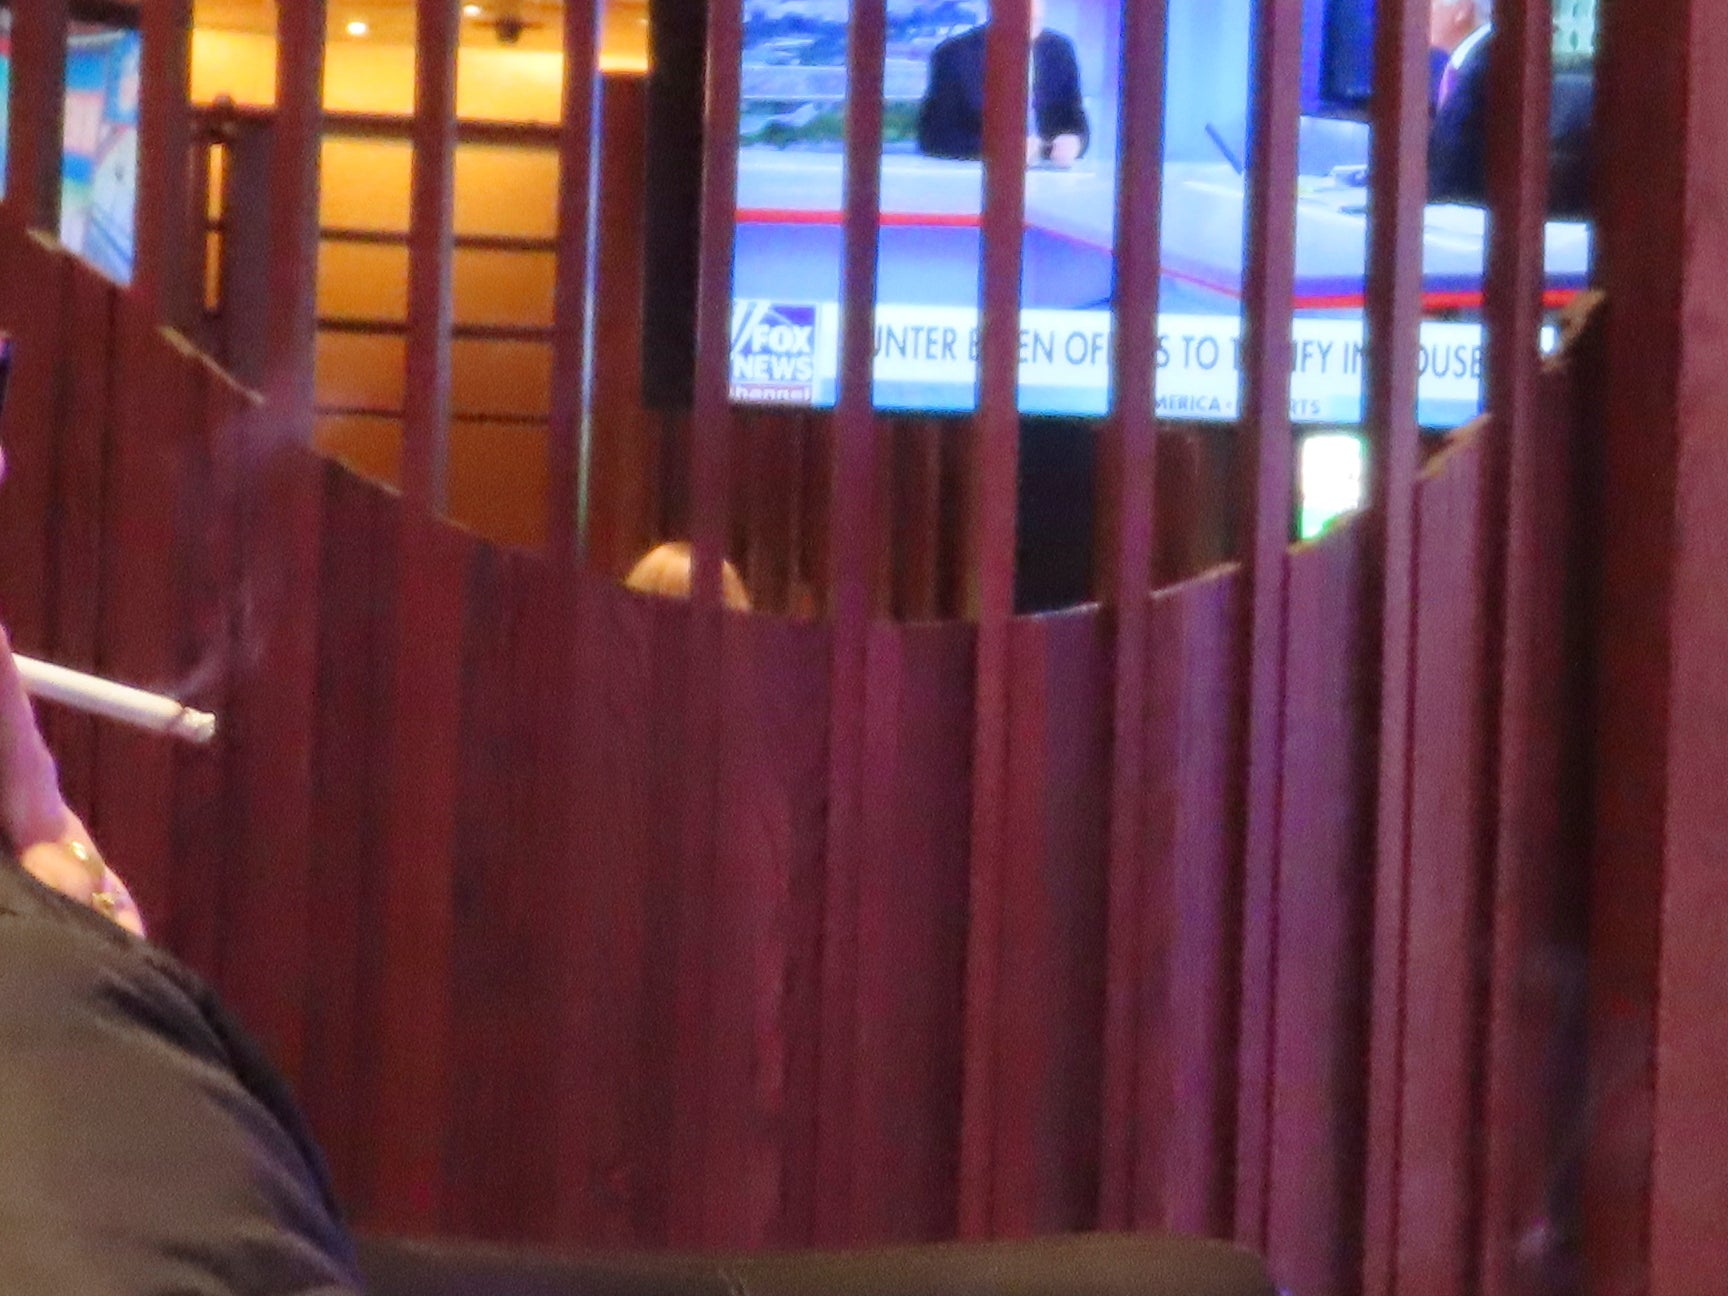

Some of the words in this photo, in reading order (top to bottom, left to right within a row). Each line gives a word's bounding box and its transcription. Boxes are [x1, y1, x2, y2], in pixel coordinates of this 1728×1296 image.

[751, 324, 813, 353] FOX
[874, 324, 956, 360] UNTER
[1182, 335, 1220, 370] TO
[733, 354, 813, 381] NEWS
